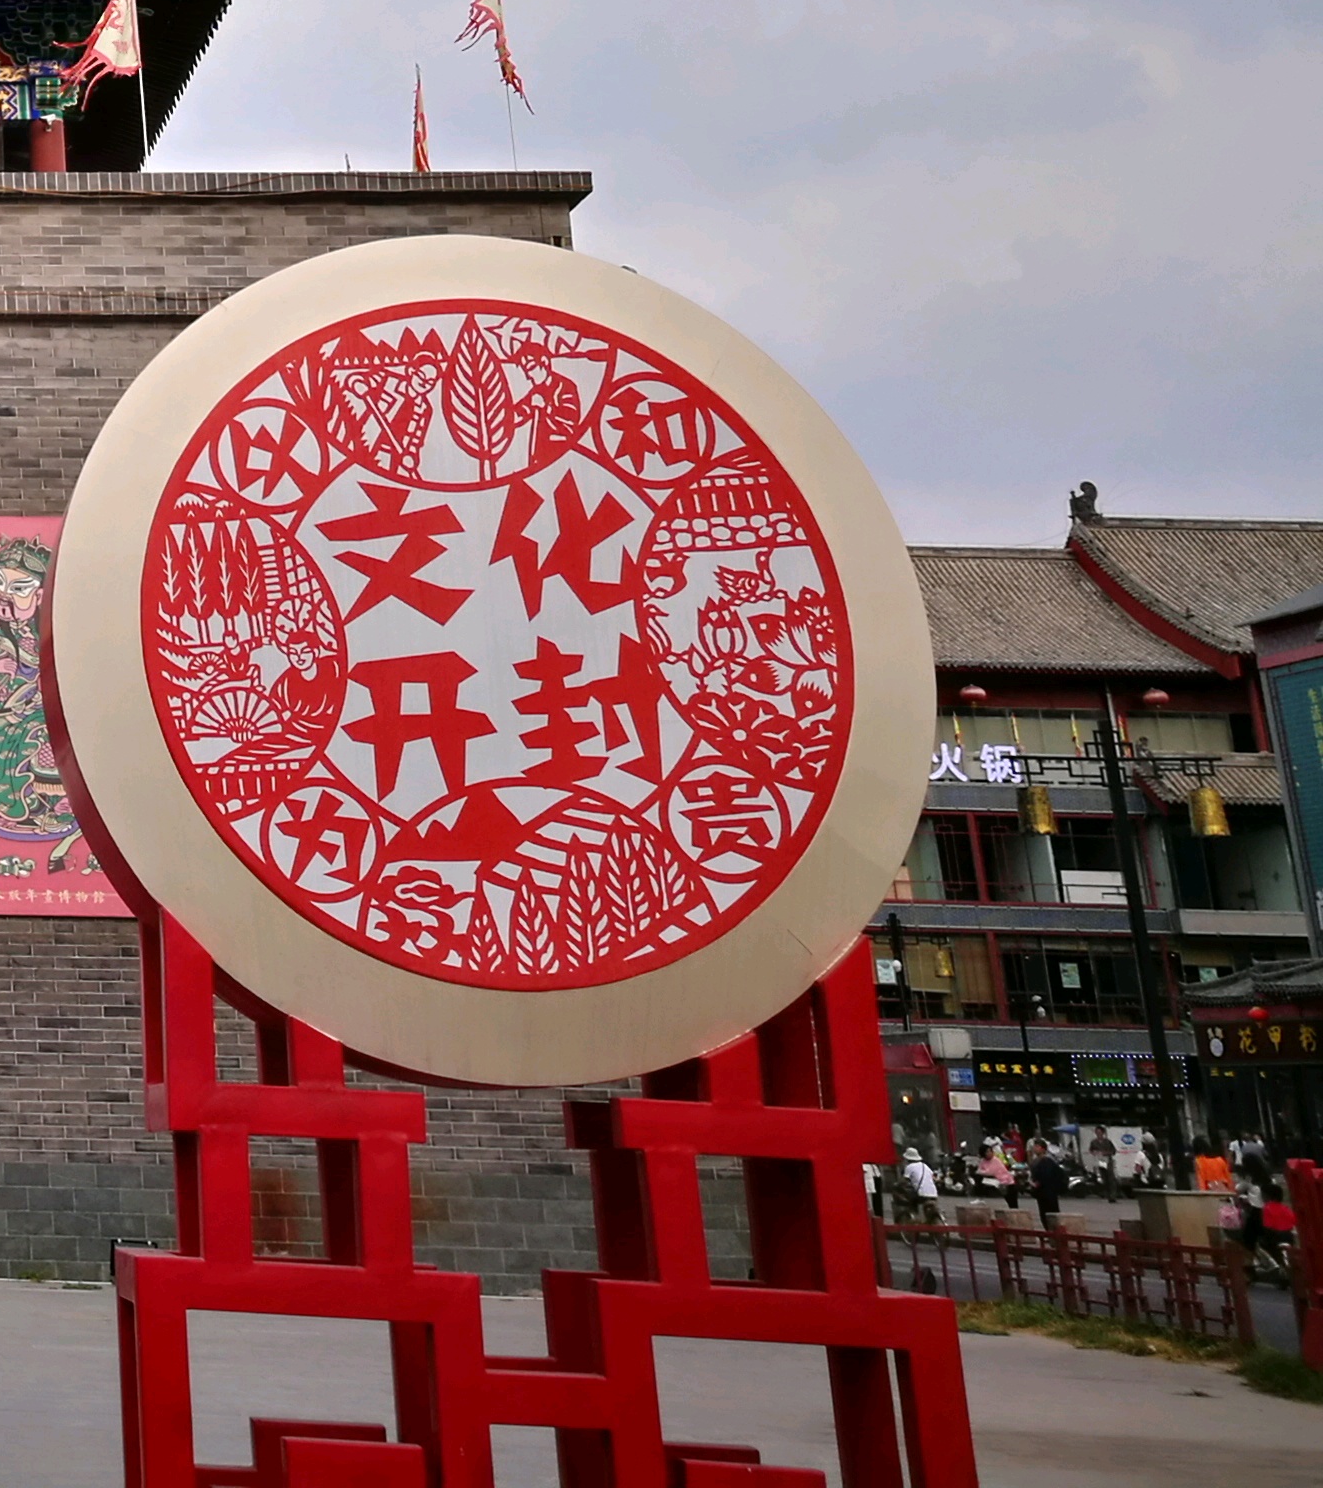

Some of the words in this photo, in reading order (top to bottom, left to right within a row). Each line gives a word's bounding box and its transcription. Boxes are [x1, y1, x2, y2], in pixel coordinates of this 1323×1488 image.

[608, 388, 702, 479] 和
[315, 469, 643, 627] 文化
[341, 632, 666, 802] 开封
